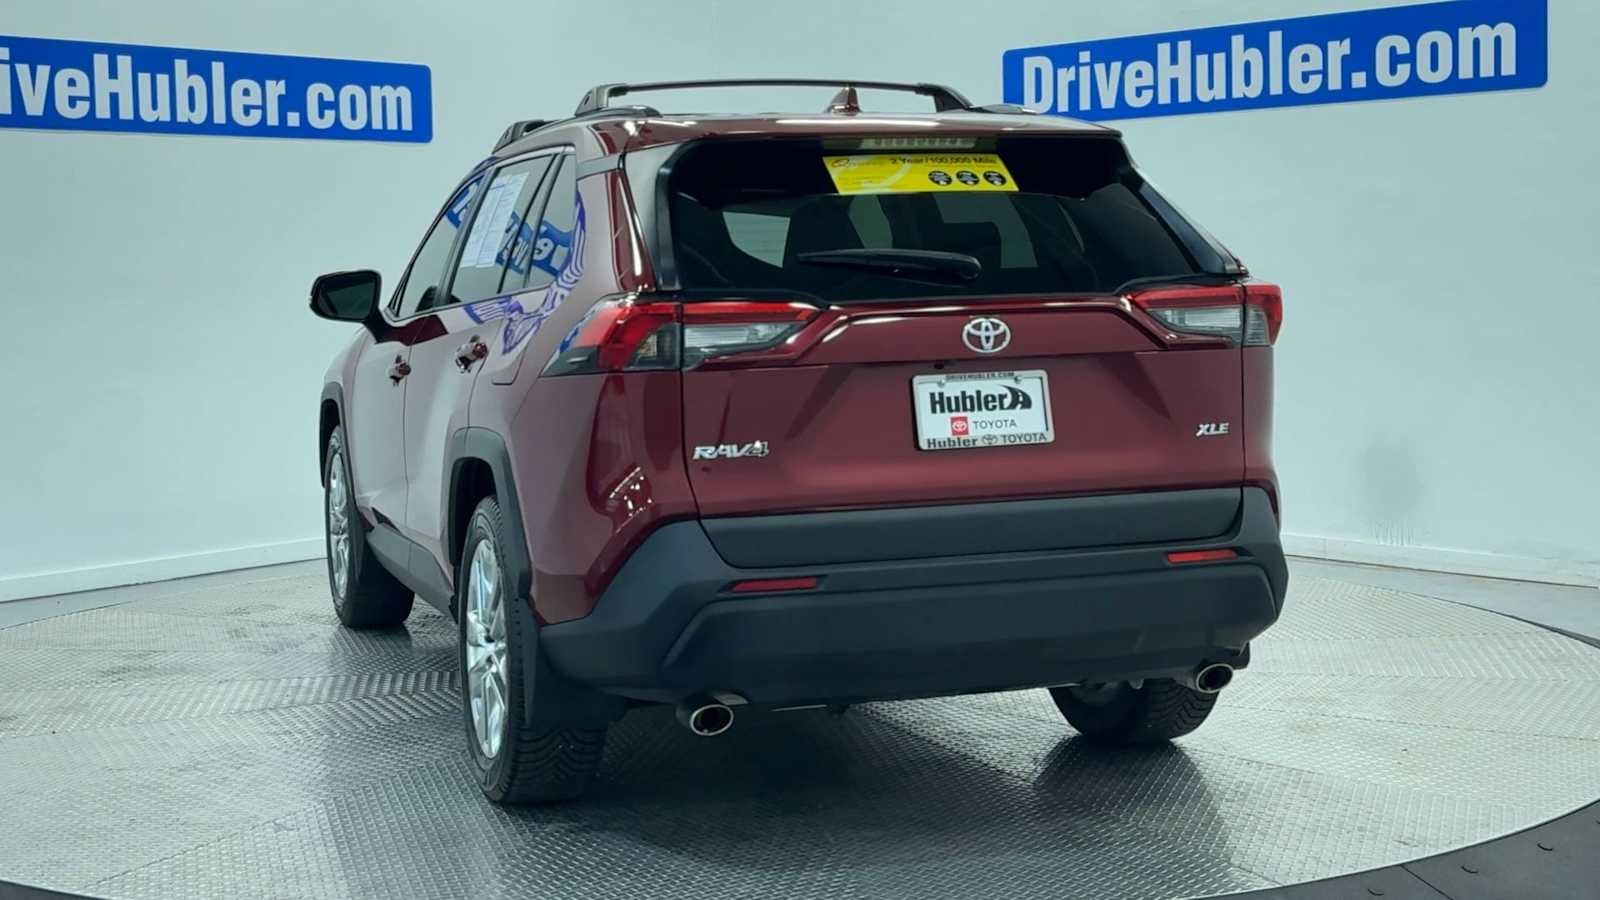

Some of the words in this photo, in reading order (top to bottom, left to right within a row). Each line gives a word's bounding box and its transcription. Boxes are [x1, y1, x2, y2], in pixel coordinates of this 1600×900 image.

[1023, 22, 1516, 115] DriveHubler.com
[929, 390, 1007, 414] Hubler
[973, 419, 1017, 430] TOYOTA
[1196, 422, 1229, 437] XLE
[927, 437, 978, 449] Hubler
[1002, 432, 1047, 444] TOYOTA
[693, 440, 769, 460] RAV4
